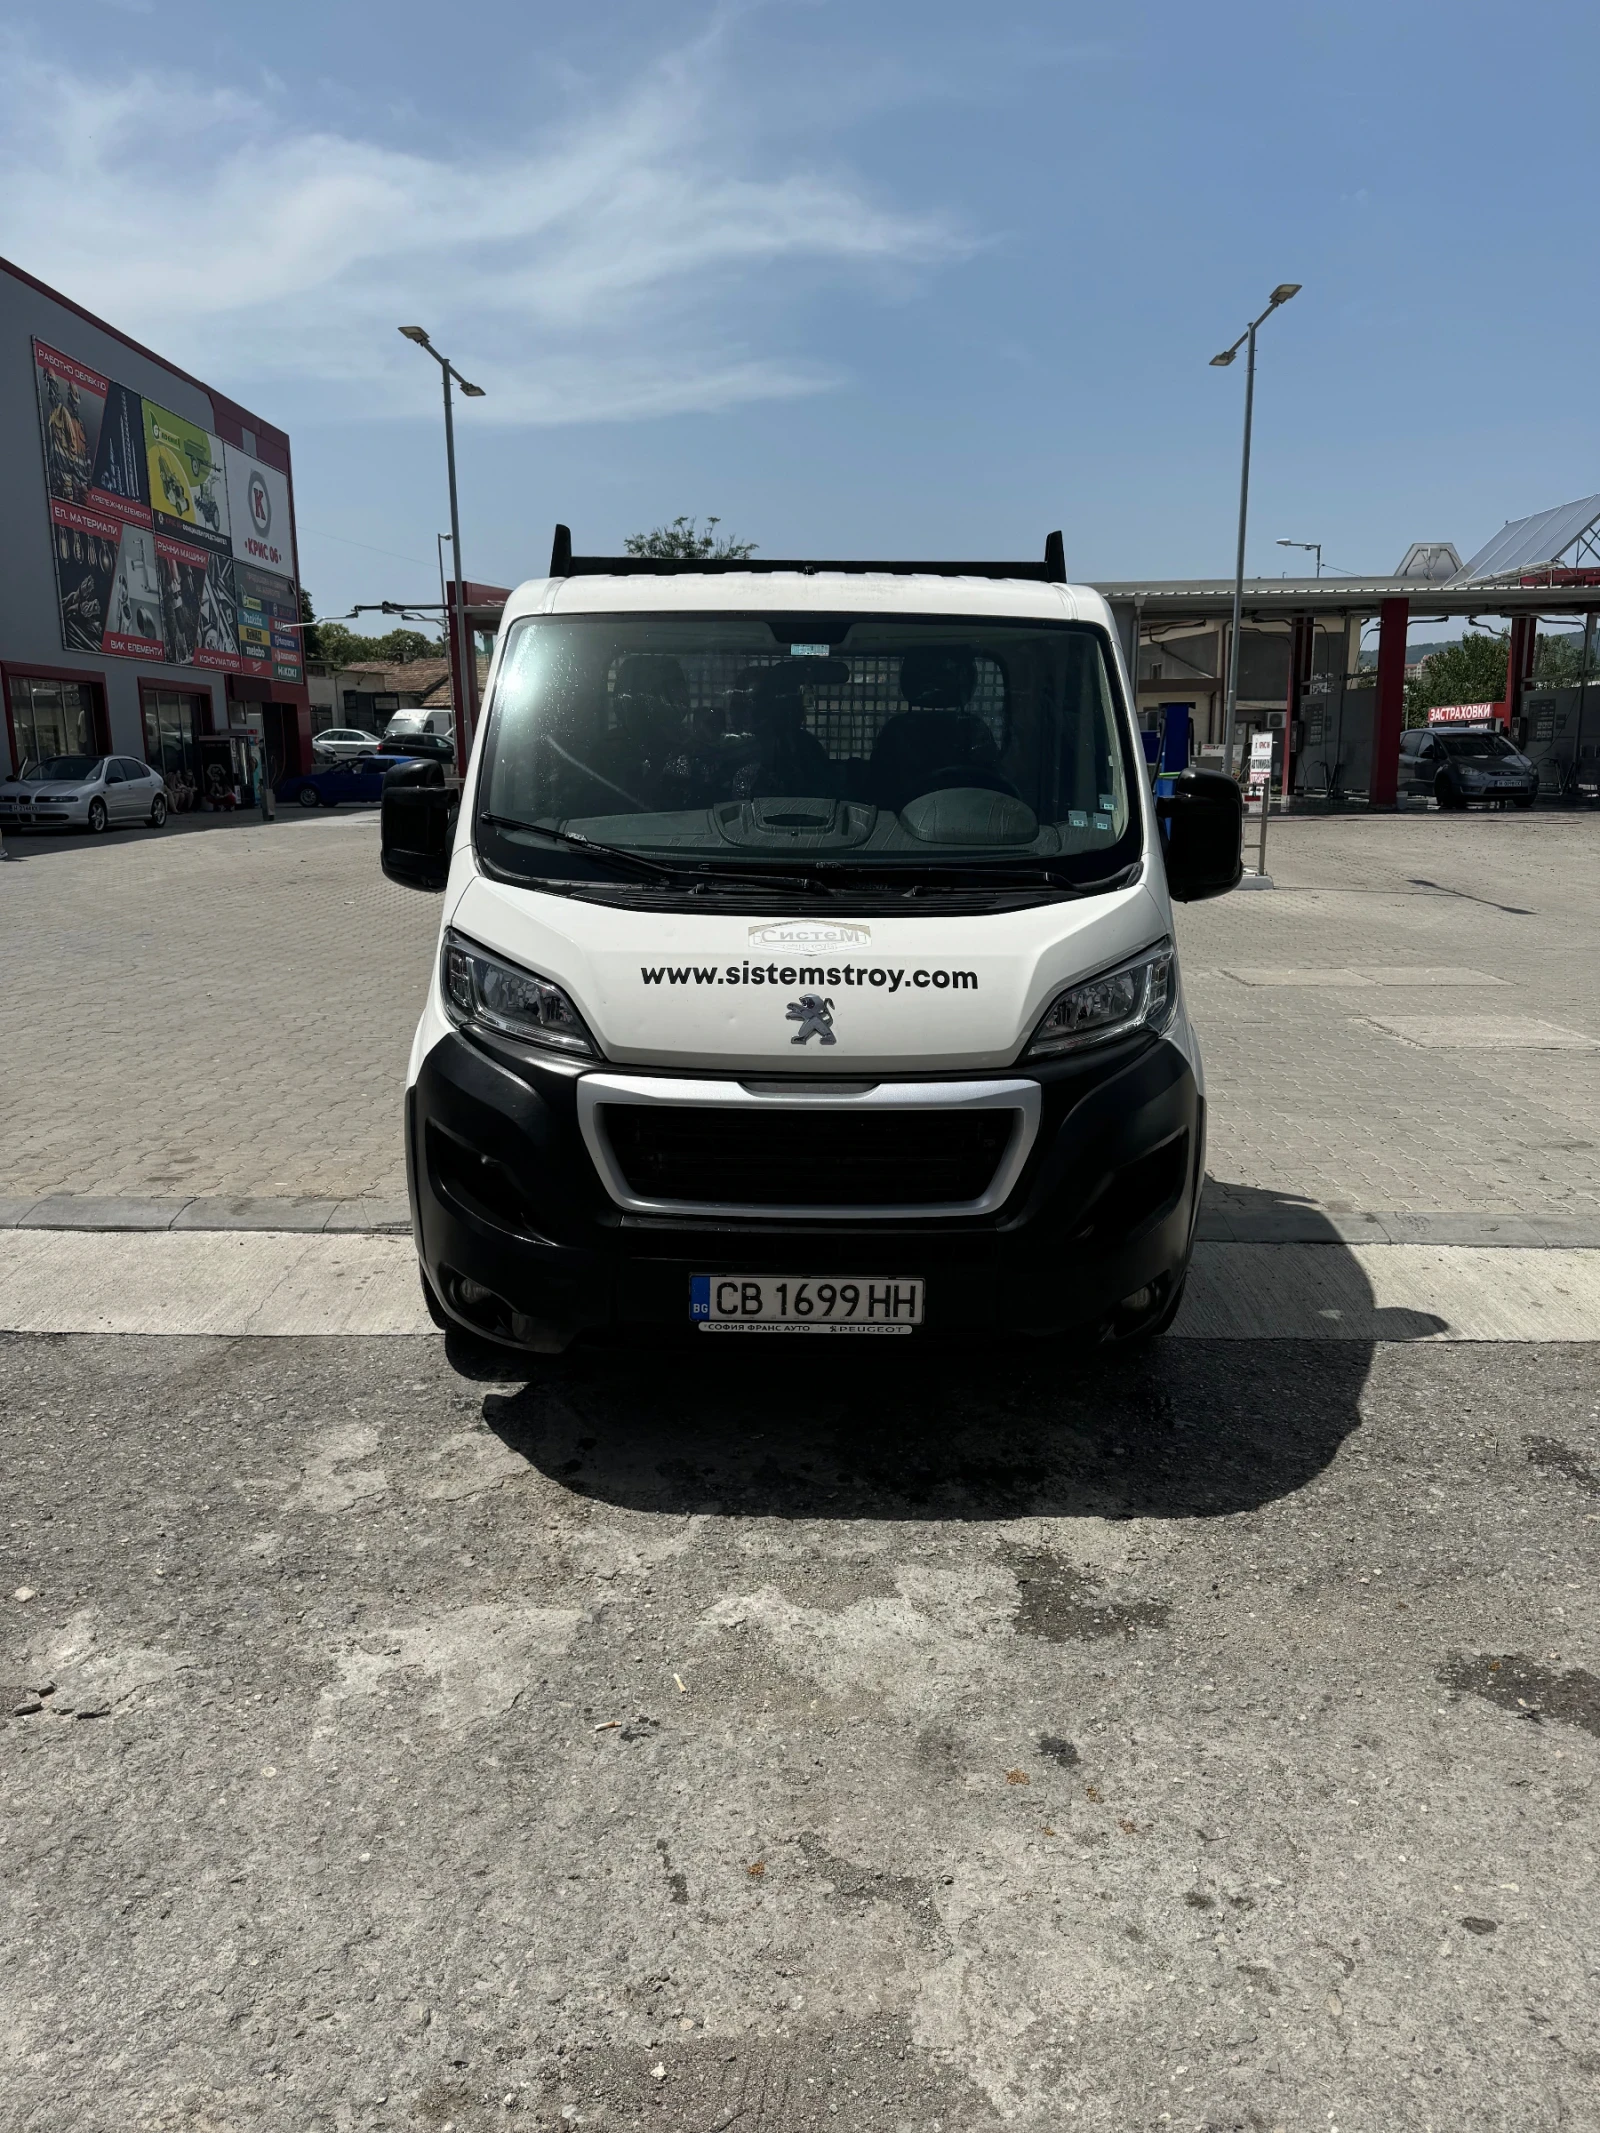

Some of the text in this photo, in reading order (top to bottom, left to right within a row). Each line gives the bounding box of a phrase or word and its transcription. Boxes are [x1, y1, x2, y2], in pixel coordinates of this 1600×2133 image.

[38, 349, 73, 375] РАБОТНО
[70, 512, 118, 535] МАТЕРИАЛИ
[157, 541, 206, 564] РЪЧНИ МАШИНИ
[247, 537, 269, 561] КРИС
[110, 640, 163, 656] ВИК ЕЛЕМЕНТИ
[199, 655, 240, 668] КОНСУМАТИВИ
[1430, 704, 1491, 721] ЗАСТРАХОВКИ
[640, 960, 979, 993] www.sistemstroy.com
[693, 1303, 708, 1313] BG
[776, 1283, 860, 1317] 1699
[708, 1323, 810, 1332] СОФИЯ ФРАНС АУТО
